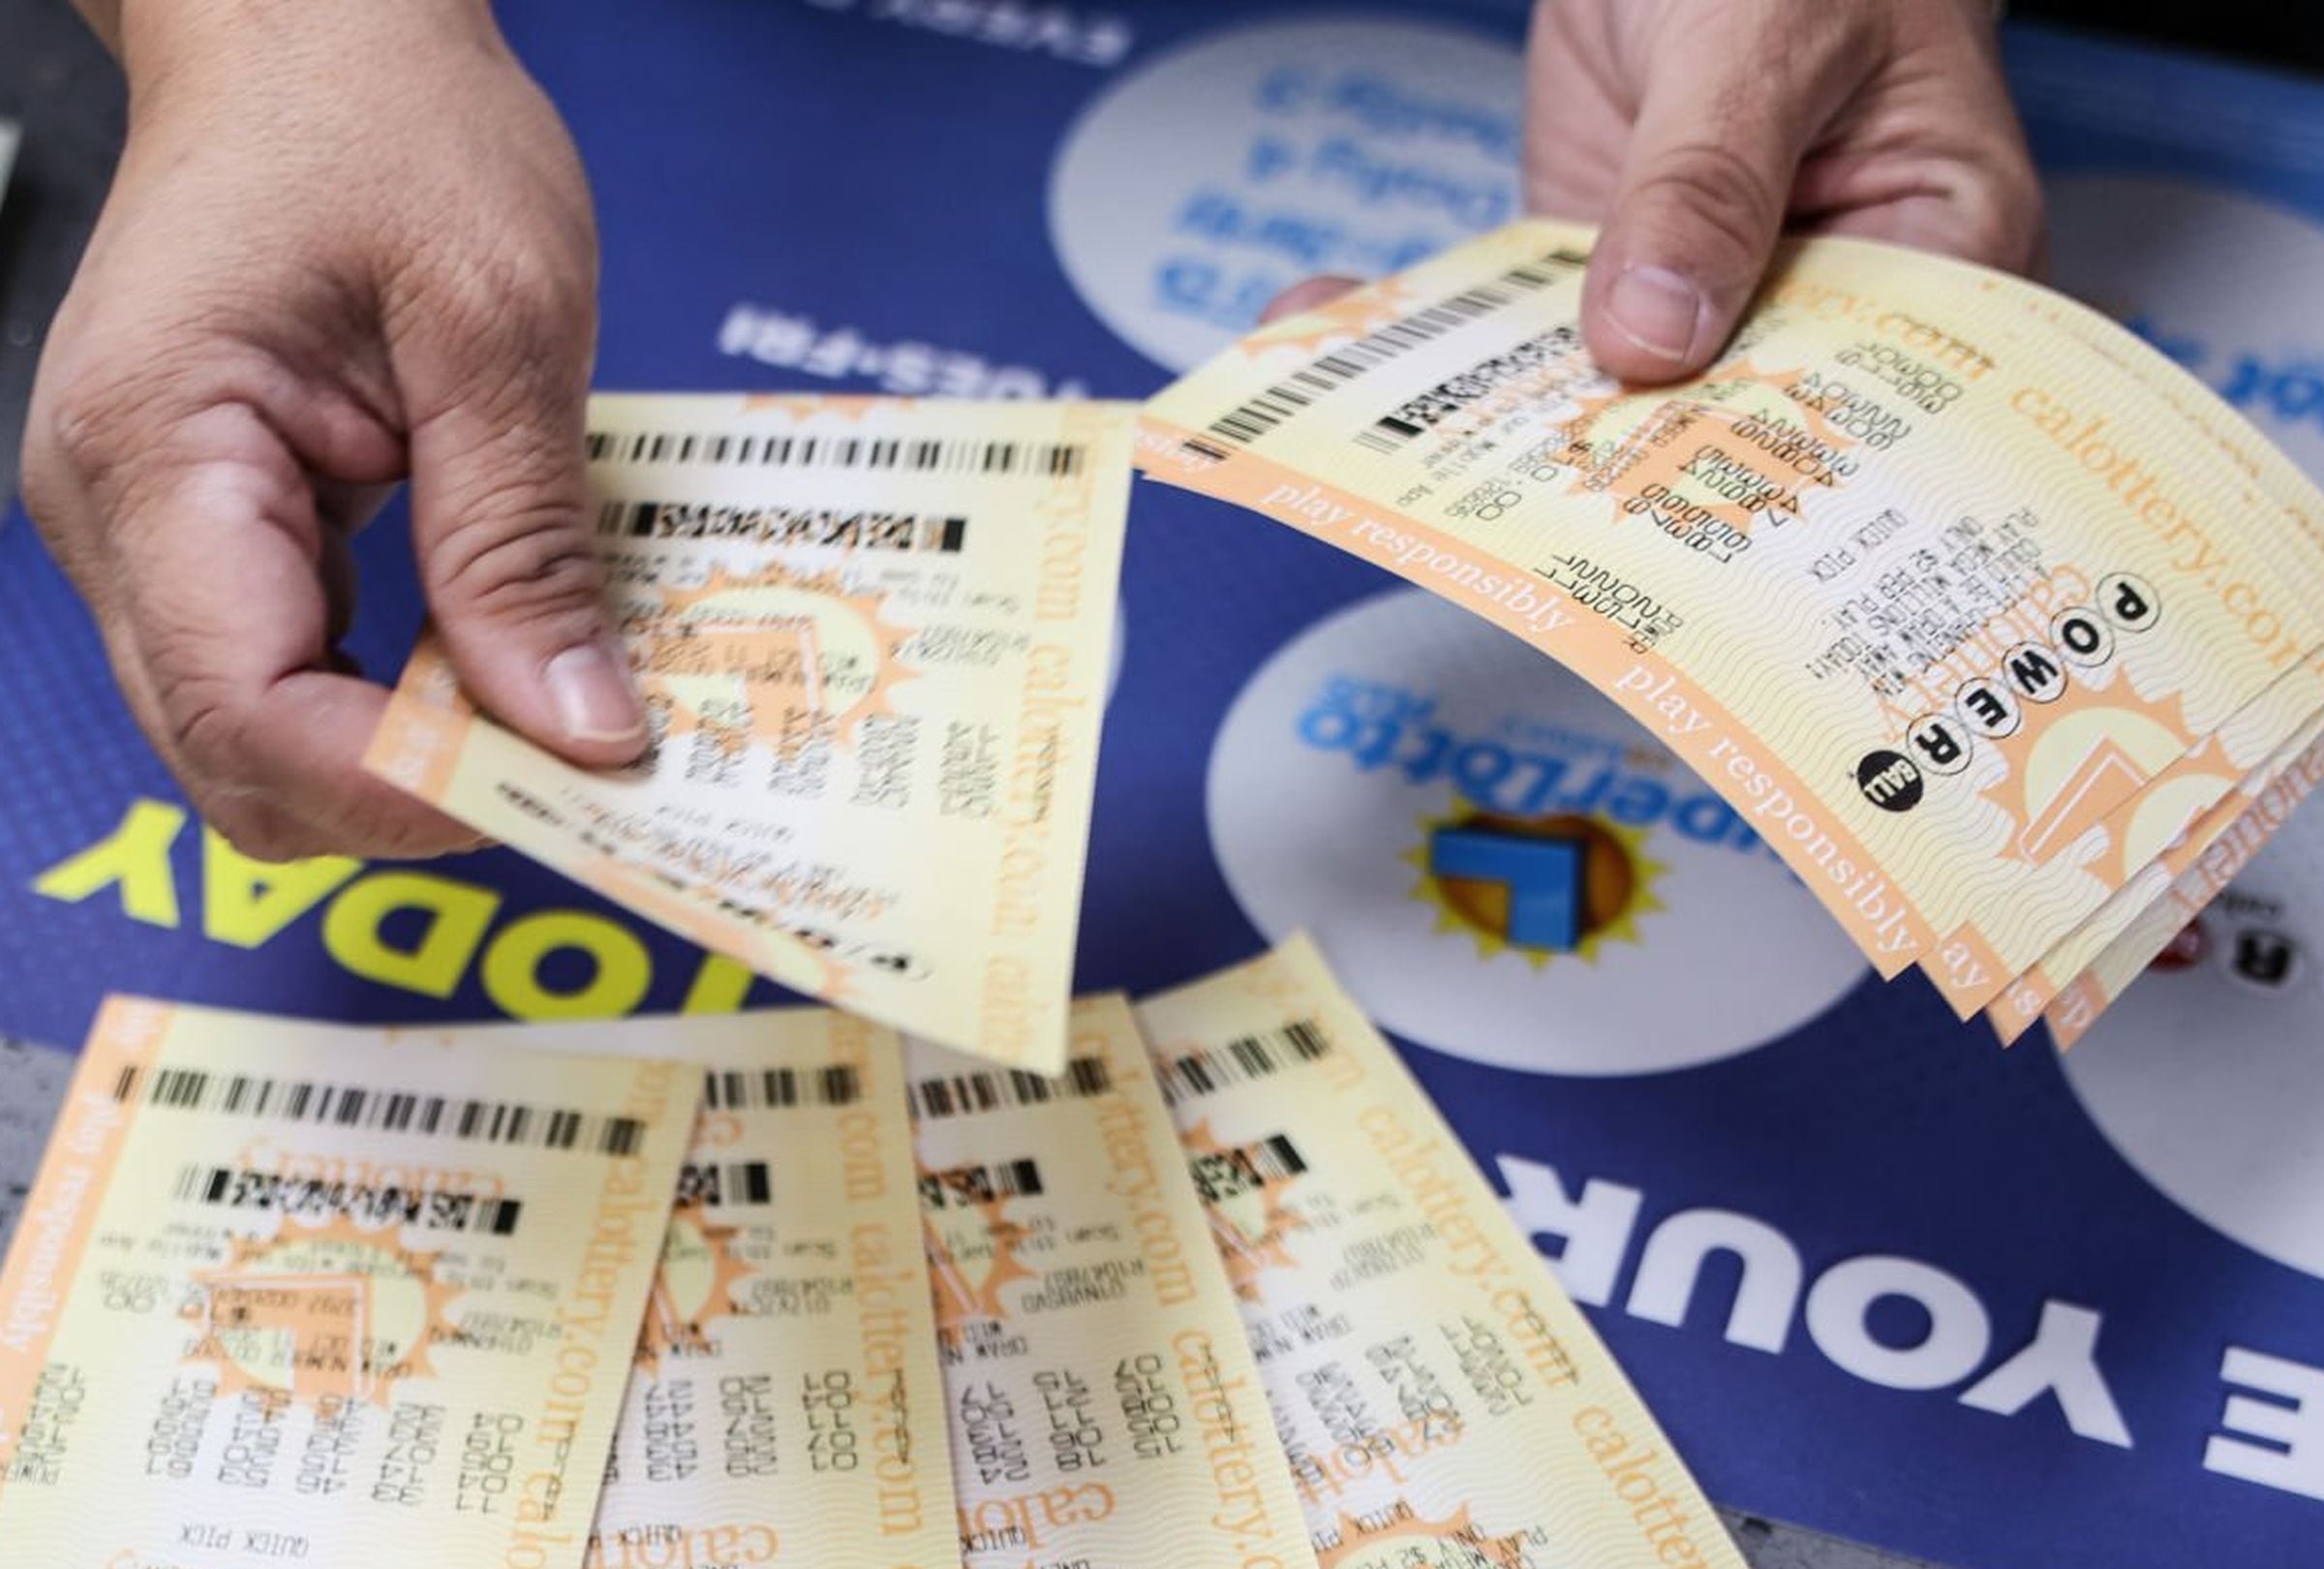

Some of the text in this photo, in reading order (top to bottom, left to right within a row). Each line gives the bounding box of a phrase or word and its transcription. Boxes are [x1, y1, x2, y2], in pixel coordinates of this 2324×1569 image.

[1813, 455, 1861, 491] 34
[1767, 494, 1803, 529] 47
[1991, 505, 2038, 549] PLAY
[1708, 531, 1753, 563] 61
[1806, 503, 1908, 587] QUICK PICK
[1936, 511, 1981, 553] ONLY
[1260, 481, 1575, 635] play responsibly
[1532, 555, 1576, 577] 11
[1553, 559, 1598, 589] 21
[1947, 538, 1994, 580] MEGA
[1571, 570, 1619, 605] 23
[1875, 565, 1911, 600] PER
[1590, 584, 1640, 618] 05
[1614, 597, 1663, 630] 21
[1867, 571, 1950, 638] MILLIONS
[1299, 704, 1762, 854] perLotto
[1614, 662, 1713, 737] play
[1713, 734, 1919, 957] responsibly
[1494, 1154, 2134, 1450] YOUR
[804, 1371, 850, 1392] 01
[961, 1354, 1162, 1404] 07 15 17
[803, 1392, 851, 1412] 04
[1048, 1407, 1095, 1429] 11
[808, 1411, 851, 1431] 11
[808, 1431, 855, 1453] 07
[811, 1453, 858, 1472] 01
[979, 1437, 1183, 1485] 15 18 24
[182, 1525, 310, 1559] QUICK PICK
[958, 1525, 1026, 1553] QUICK
